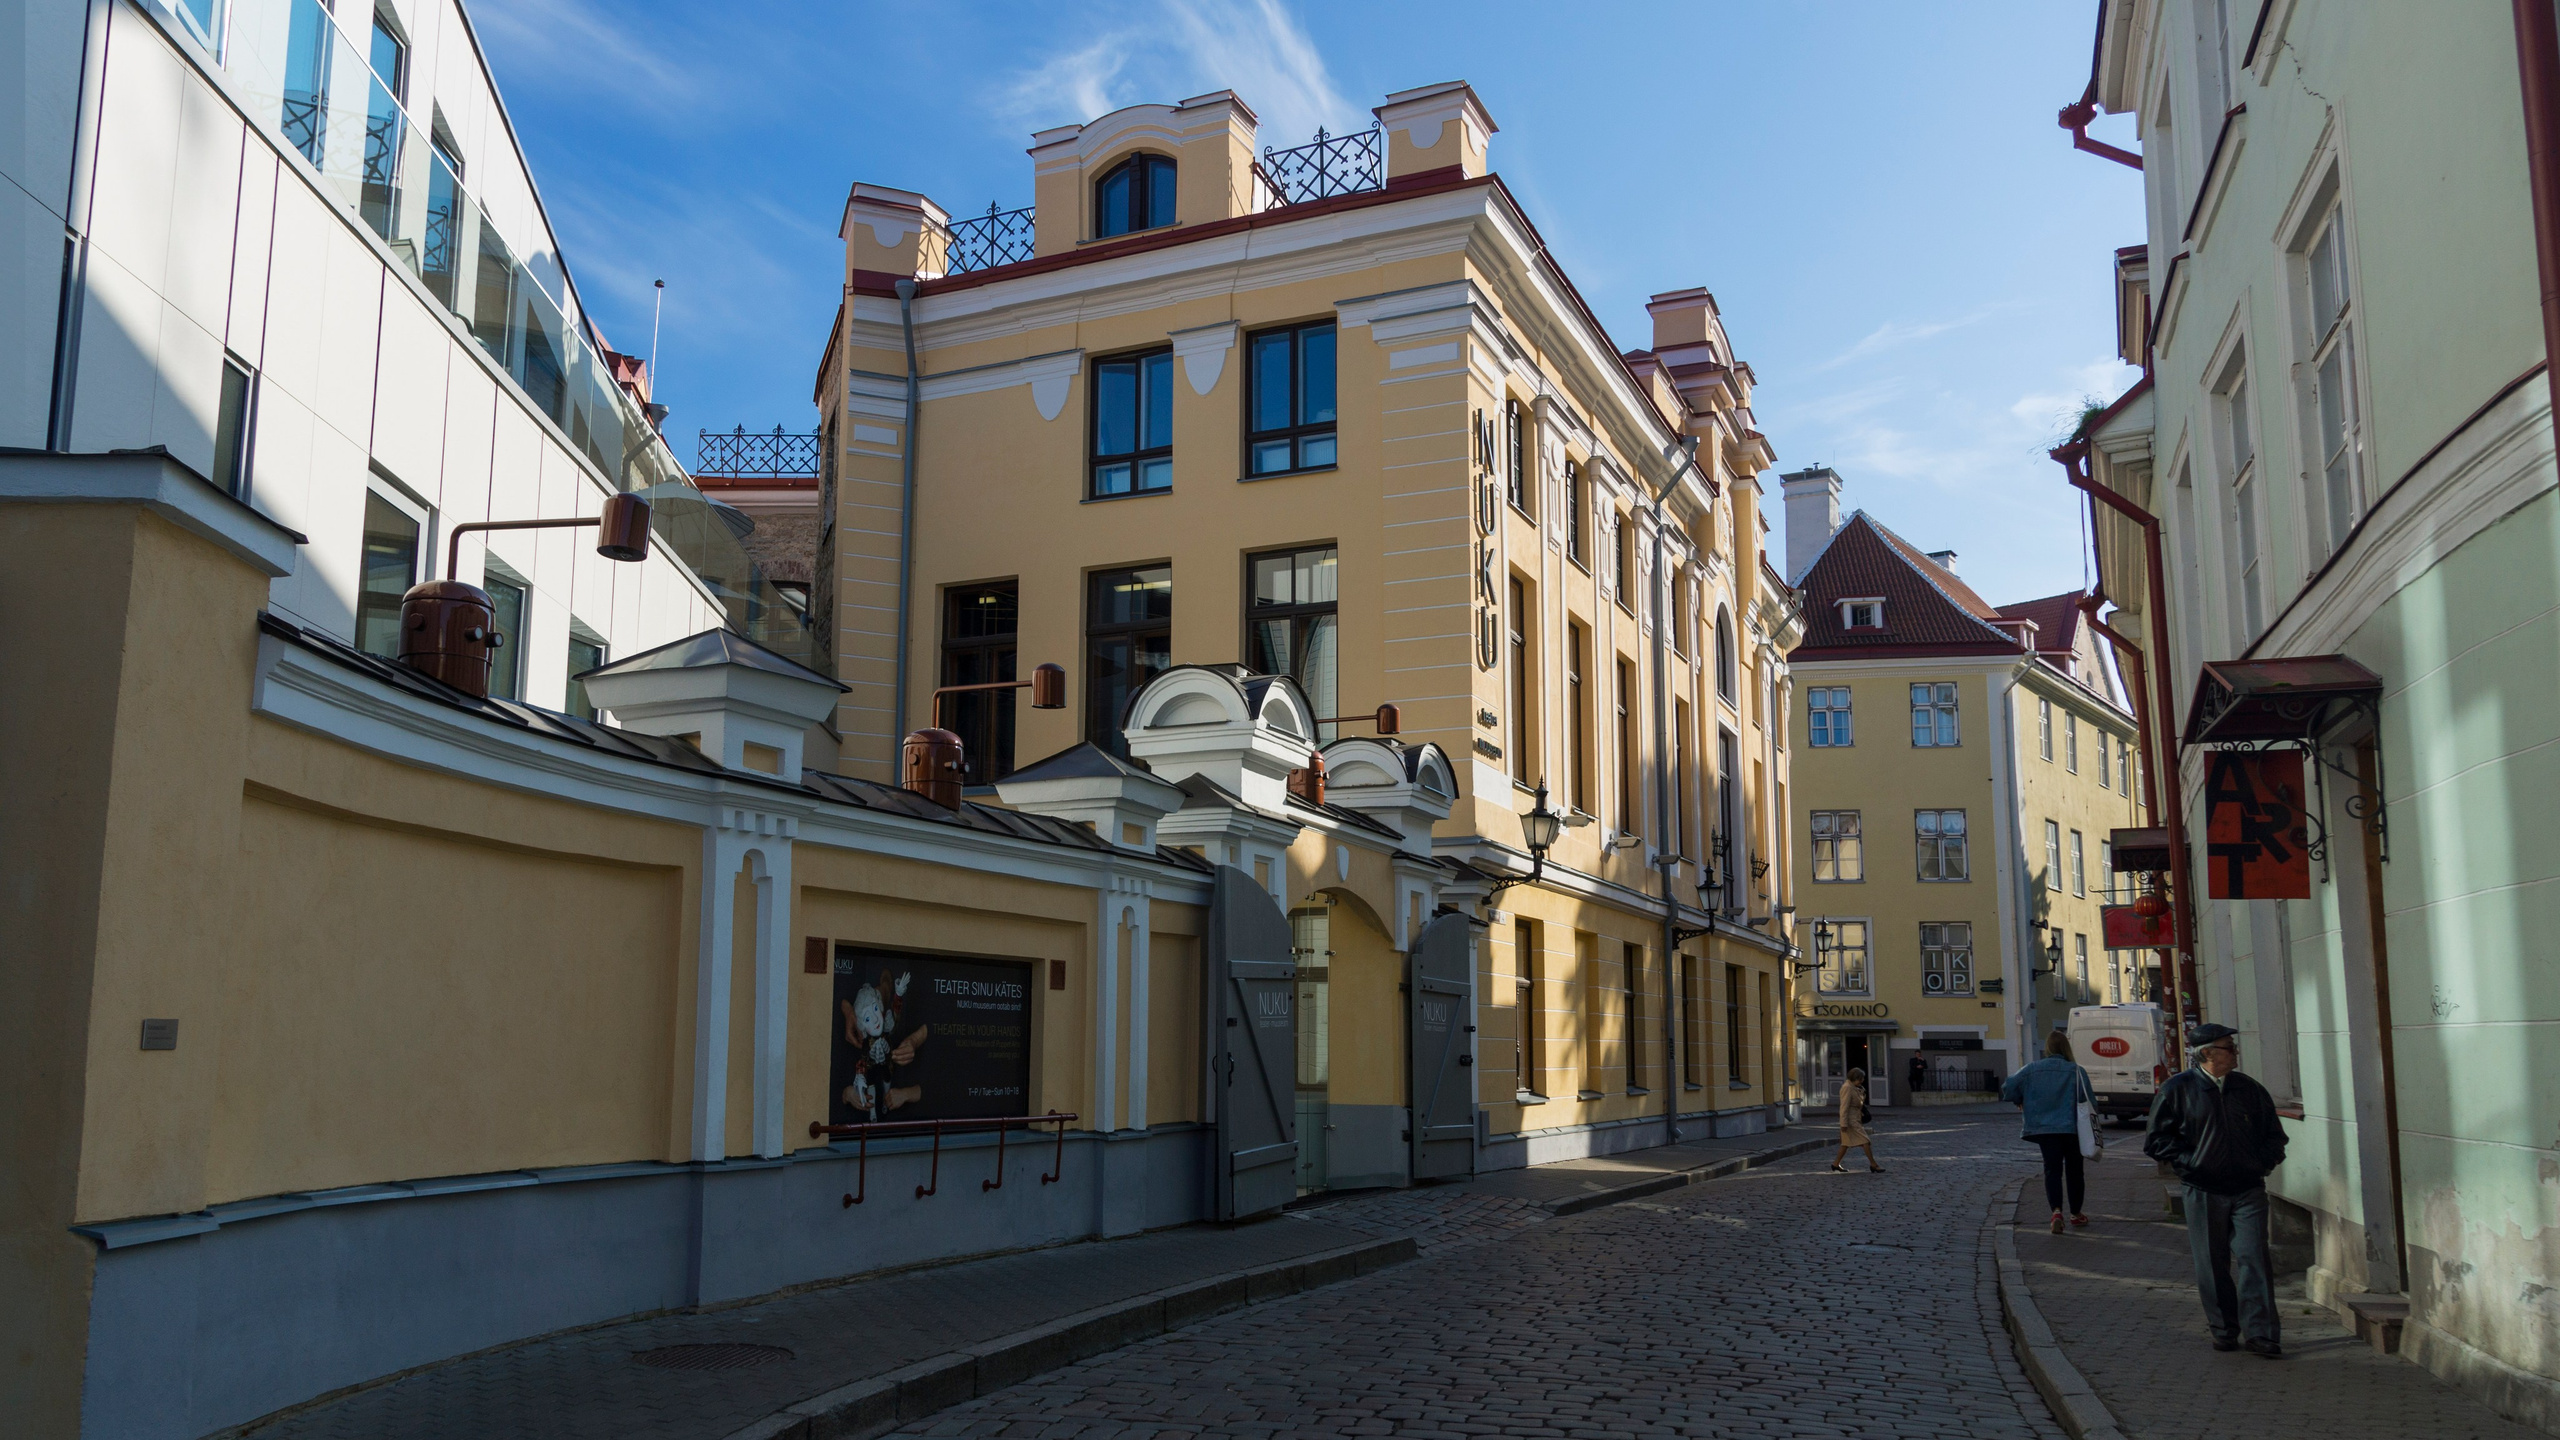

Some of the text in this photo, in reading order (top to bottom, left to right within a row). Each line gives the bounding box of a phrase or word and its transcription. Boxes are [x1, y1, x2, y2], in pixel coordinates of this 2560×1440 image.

[1478, 407, 1498, 669] NUKU
[934, 978, 1023, 998] TEATER SINU KÄTES
[956, 1000, 972, 1009] NUKU
[1259, 991, 1289, 1015] NUKU
[1423, 1001, 1447, 1022] NUKU
[933, 1023, 1021, 1037] THEATRE IN YOUR HANDS
